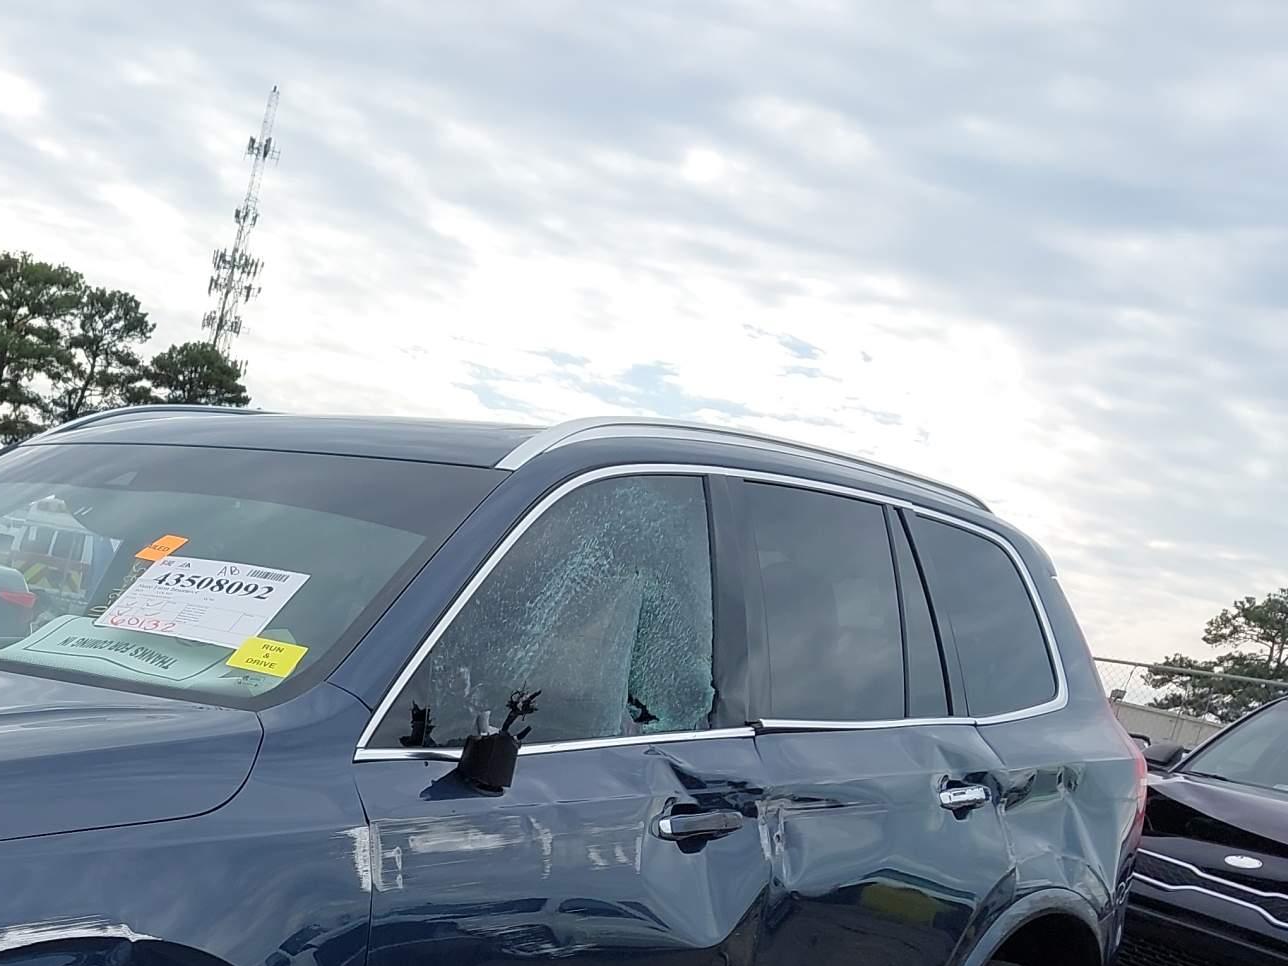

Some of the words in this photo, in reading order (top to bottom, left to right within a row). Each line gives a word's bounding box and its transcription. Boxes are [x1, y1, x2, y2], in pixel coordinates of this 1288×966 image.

[153, 571, 275, 600] 43508092
[110, 615, 176, 632] 60132
[59, 637, 78, 648] IN
[73, 638, 113, 651] COMING
[111, 640, 137, 655] FOR
[261, 642, 285, 654] RUN
[130, 647, 177, 669] THANKS
[262, 651, 271, 660] &
[245, 657, 277, 670] DRIVE
